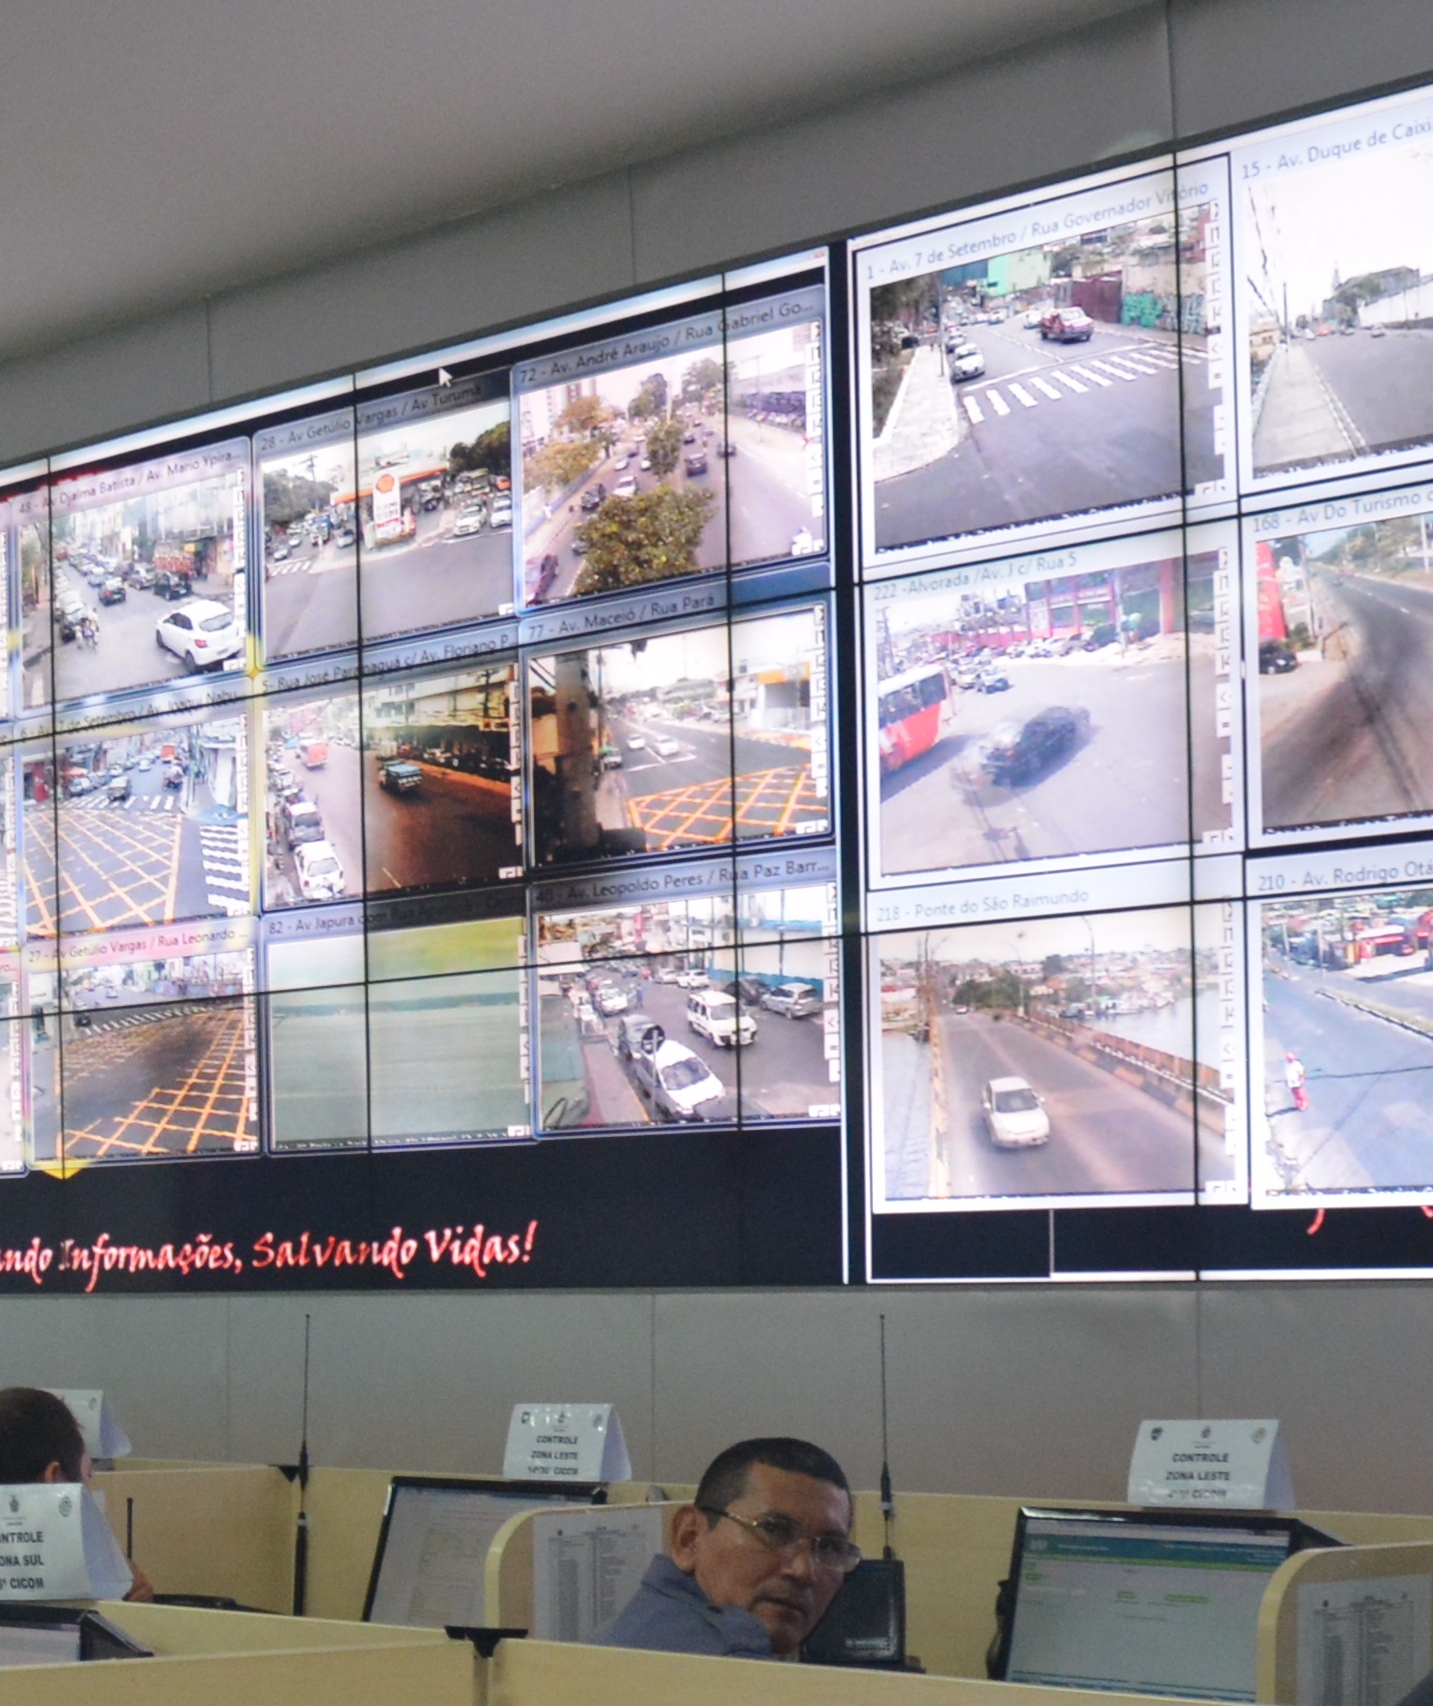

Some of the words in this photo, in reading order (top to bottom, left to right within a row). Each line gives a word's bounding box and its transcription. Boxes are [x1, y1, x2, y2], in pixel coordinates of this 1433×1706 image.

[1242, 161, 1260, 179] 15
[1277, 152, 1303, 170] Av.
[1307, 138, 1362, 163] Duque
[1366, 130, 1387, 147] de
[866, 267, 873, 280] 1
[889, 258, 911, 273] Av.
[916, 253, 923, 267] 7
[927, 249, 945, 264] de
[948, 233, 1017, 260] Setembro
[1031, 221, 1060, 237] Rua
[1064, 198, 1153, 229] Governador
[520, 369, 536, 382] 72
[551, 362, 571, 374] Av.
[576, 350, 619, 368] André
[686, 326, 713, 340] Rua
[717, 309, 774, 331] Gabriel
[262, 437, 275, 450] 28
[307, 420, 351, 438] Getúlio
[356, 408, 398, 426] Vargas
[99, 476, 135, 494] Batista
[1253, 516, 1280, 532] 168
[1324, 506, 1346, 520] Do
[1353, 492, 1420, 515] Turismo
[875, 584, 896, 599] 222
[1037, 557, 1064, 571] Rua
[528, 625, 544, 639] 77
[585, 610, 634, 629] Maceió
[651, 602, 678, 616] Rua
[278, 677, 300, 689] Rua
[593, 879, 659, 899] Leopoldo
[664, 873, 702, 888] Peres
[754, 865, 780, 878] Paz
[1258, 876, 1284, 892] 210
[1302, 870, 1327, 887] Av.
[1334, 864, 1398, 885] Rodrigo
[878, 907, 900, 923] 218
[915, 903, 955, 918] Ponte
[960, 900, 978, 914] do
[983, 896, 1008, 912] São
[1013, 889, 1089, 908] Raimundo
[110, 938, 147, 955] Vargas
[158, 936, 178, 948] Rua
[182, 929, 235, 945] Leonardo
[269, 922, 283, 934] 82
[59, 1232, 242, 1293] Informações,
[253, 1226, 417, 1279] Salvando
[424, 1220, 538, 1279] Vidas!
[1172, 1453, 1229, 1463] CONTROLE
[1165, 1471, 1194, 1481] ZONA
[1198, 1471, 1231, 1481] LESTE
[23, 1554, 44, 1567] SUL
[9, 1578, 44, 1590] CICOM
